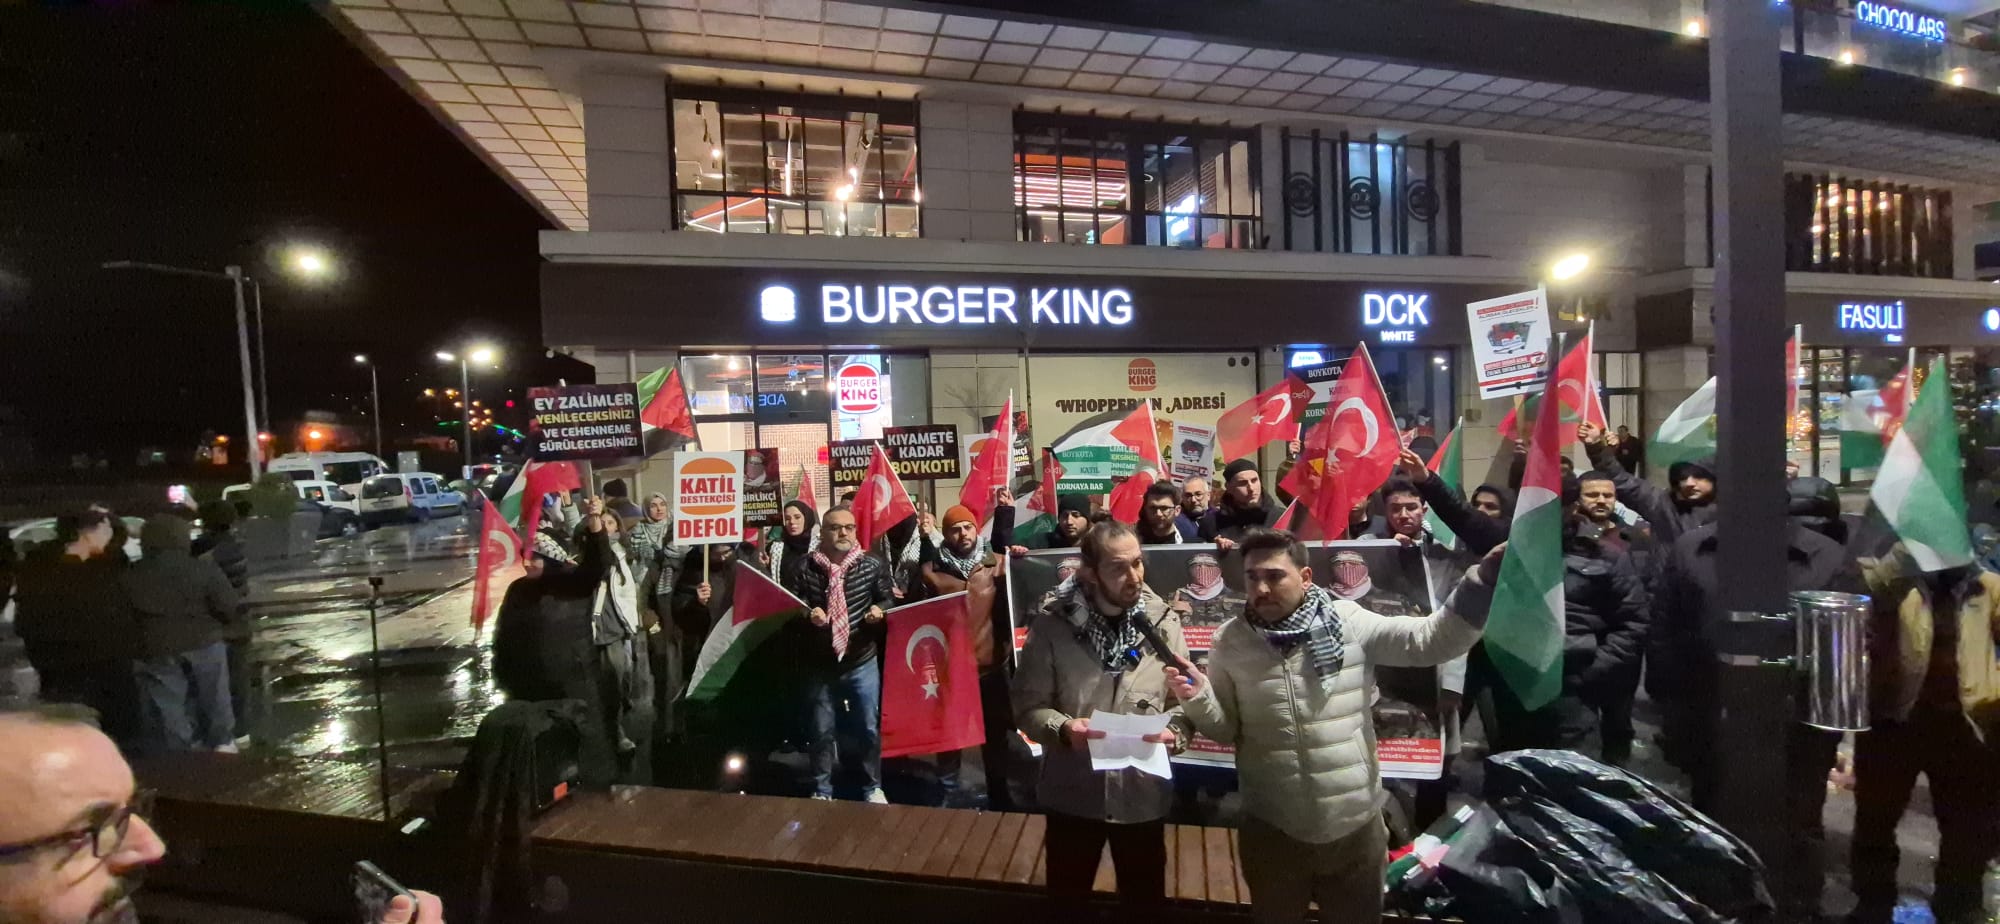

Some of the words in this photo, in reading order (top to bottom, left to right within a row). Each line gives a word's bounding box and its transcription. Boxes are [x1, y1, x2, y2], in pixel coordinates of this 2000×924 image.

[1857, 0, 1945, 40] CHOCOLABS
[821, 285, 1018, 324] BURGER
[1031, 287, 1133, 325] KING
[1363, 293, 1430, 325] DCK
[1841, 301, 1903, 329] FASULİ
[1380, 330, 1416, 342] WHITE
[1128, 368, 1156, 376] BURGER
[1308, 366, 1343, 378] BOYKOTA
[840, 379, 878, 387] BURGER
[1128, 376, 1157, 385] KING
[841, 388, 878, 400] KING
[534, 398, 554, 411] EY
[557, 392, 634, 409] ZALİMLER
[1166, 392, 1226, 413] ADRESİ
[542, 428, 559, 438] VE
[561, 424, 631, 437] CEHENNEME
[887, 431, 954, 446] KIYAMETE
[831, 445, 884, 457] KIYAME
[899, 445, 945, 459] KADAR
[841, 457, 871, 468] KADA
[891, 459, 956, 475] BOYKOT!
[680, 474, 736, 494] KATİL
[680, 494, 735, 504] DESTEKÇİSİ
[678, 518, 738, 538] DEFOL
